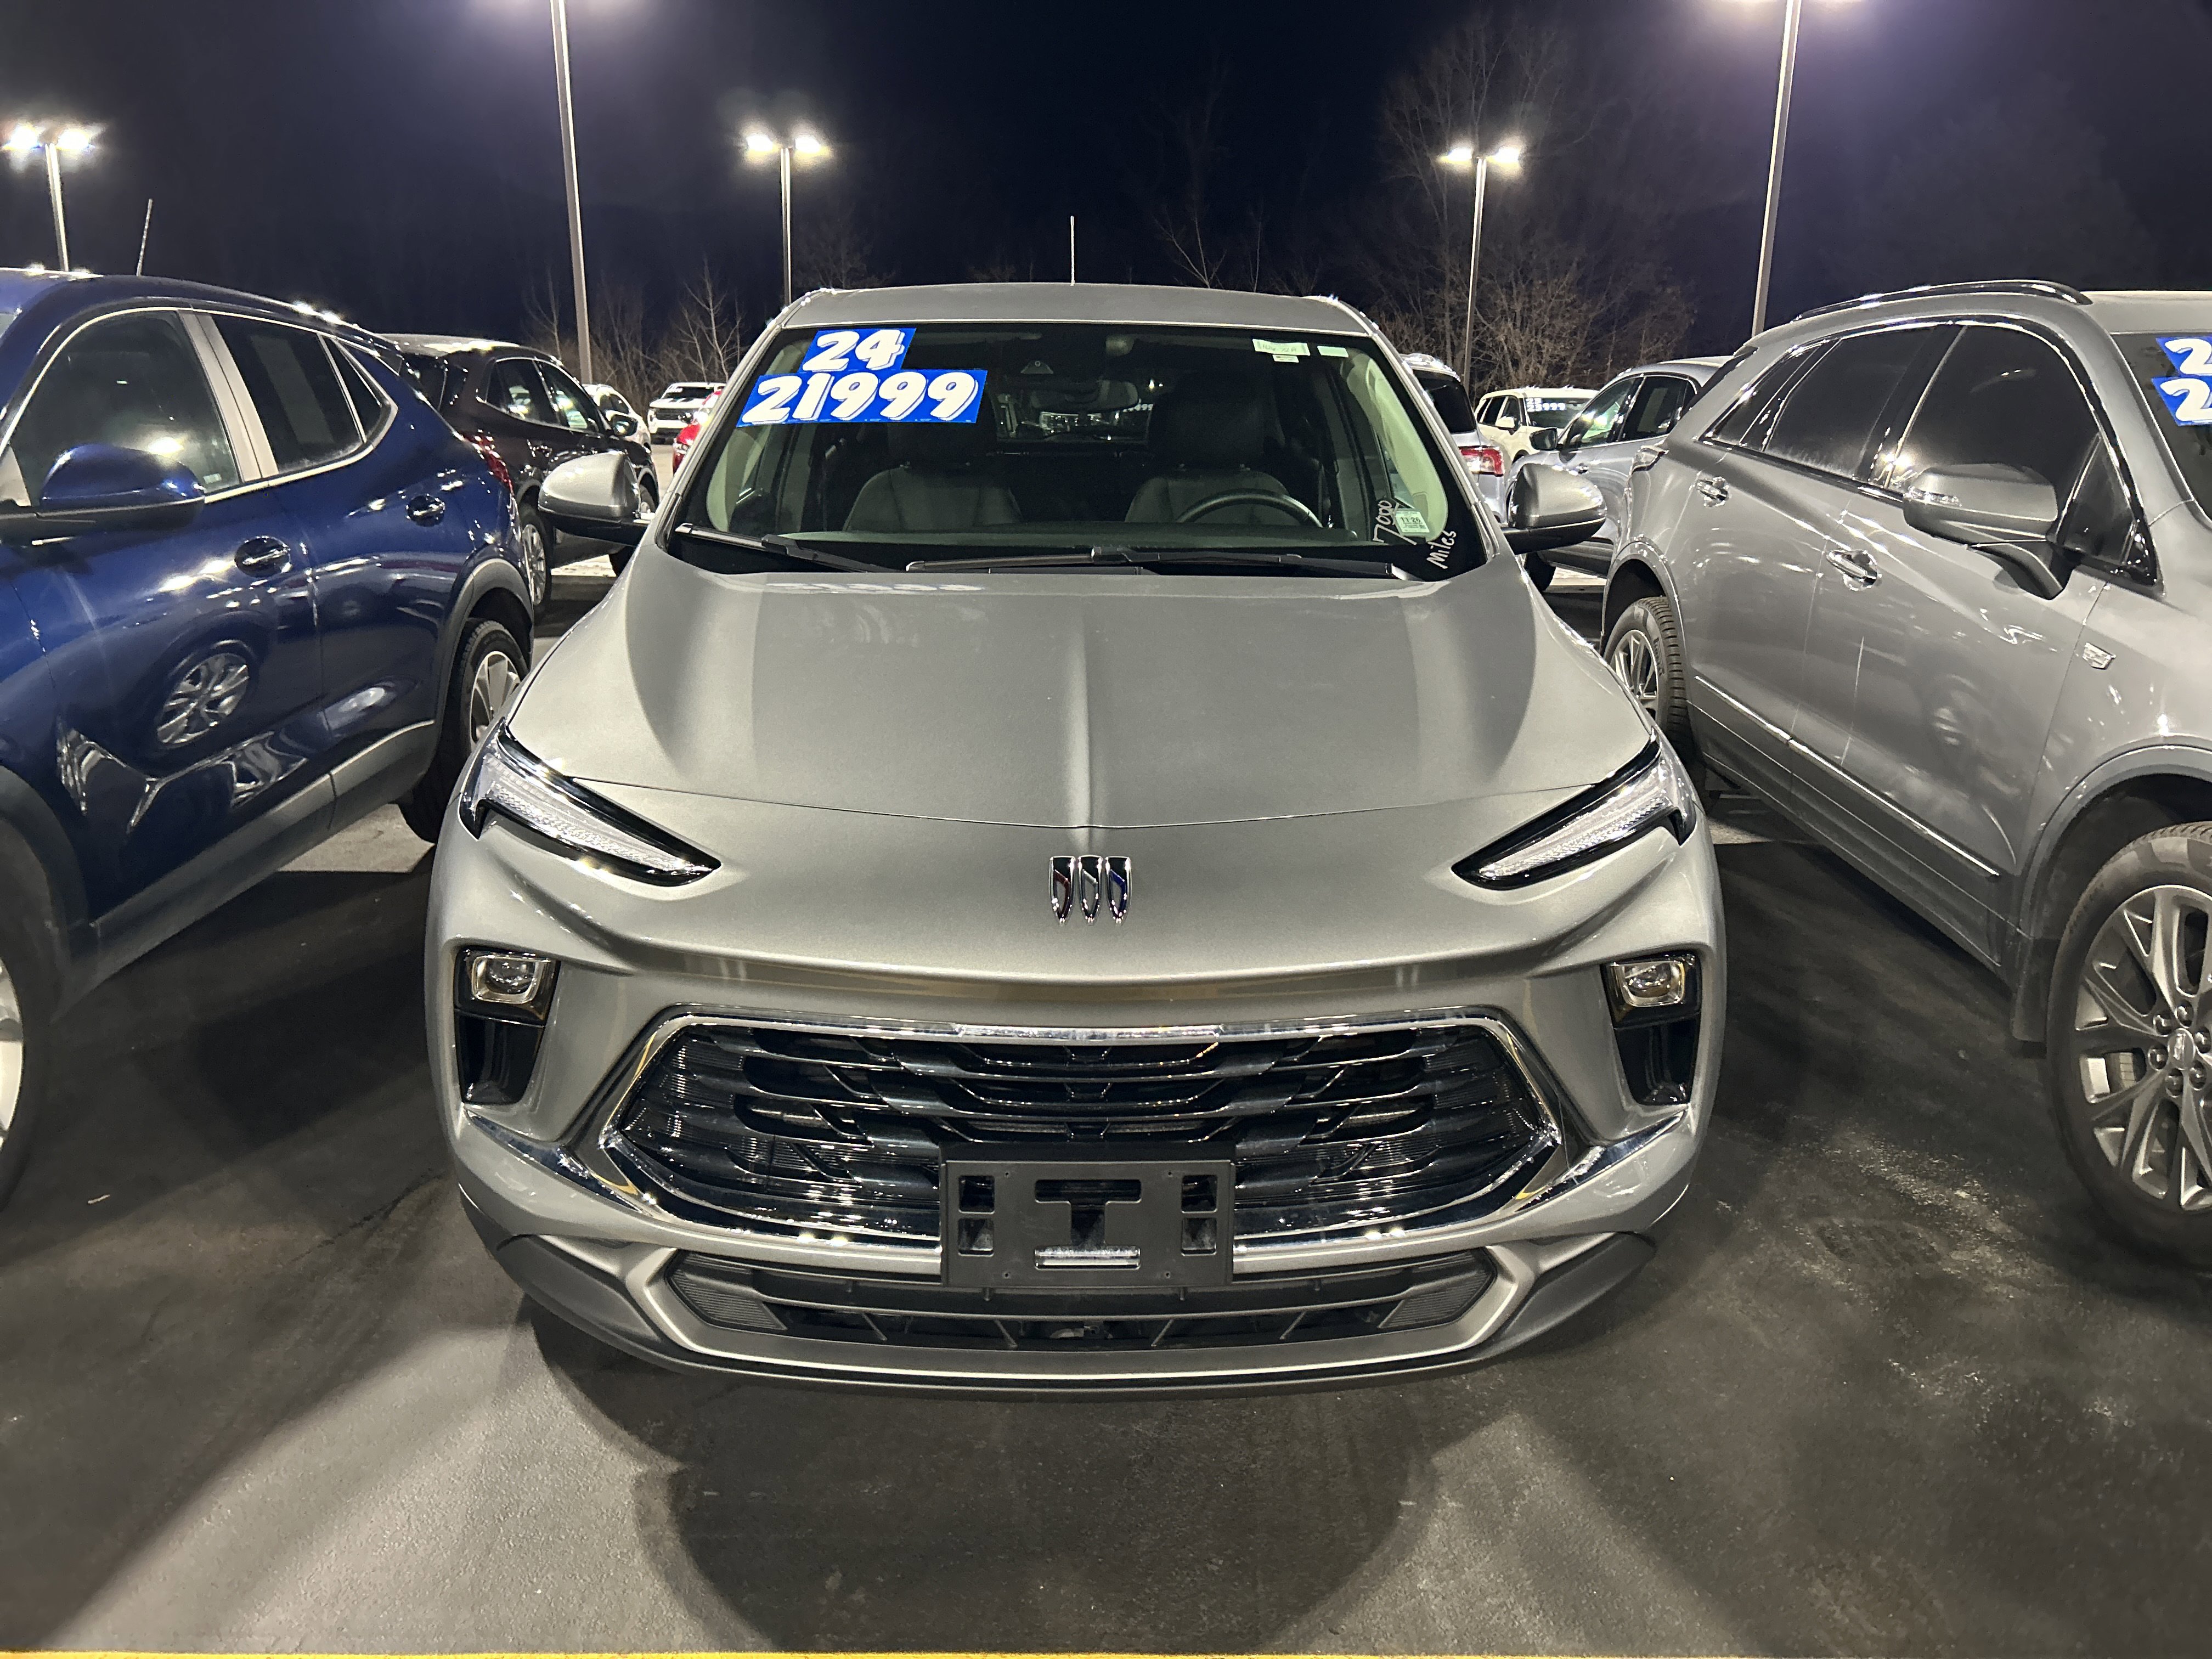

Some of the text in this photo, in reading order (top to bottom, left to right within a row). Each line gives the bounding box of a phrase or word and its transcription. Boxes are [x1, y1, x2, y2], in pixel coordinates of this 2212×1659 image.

[803, 329, 905, 372] 24
[742, 372, 979, 425] 21999
[1373, 500, 1417, 545] 7000
[1426, 529, 1457, 569] Miles
